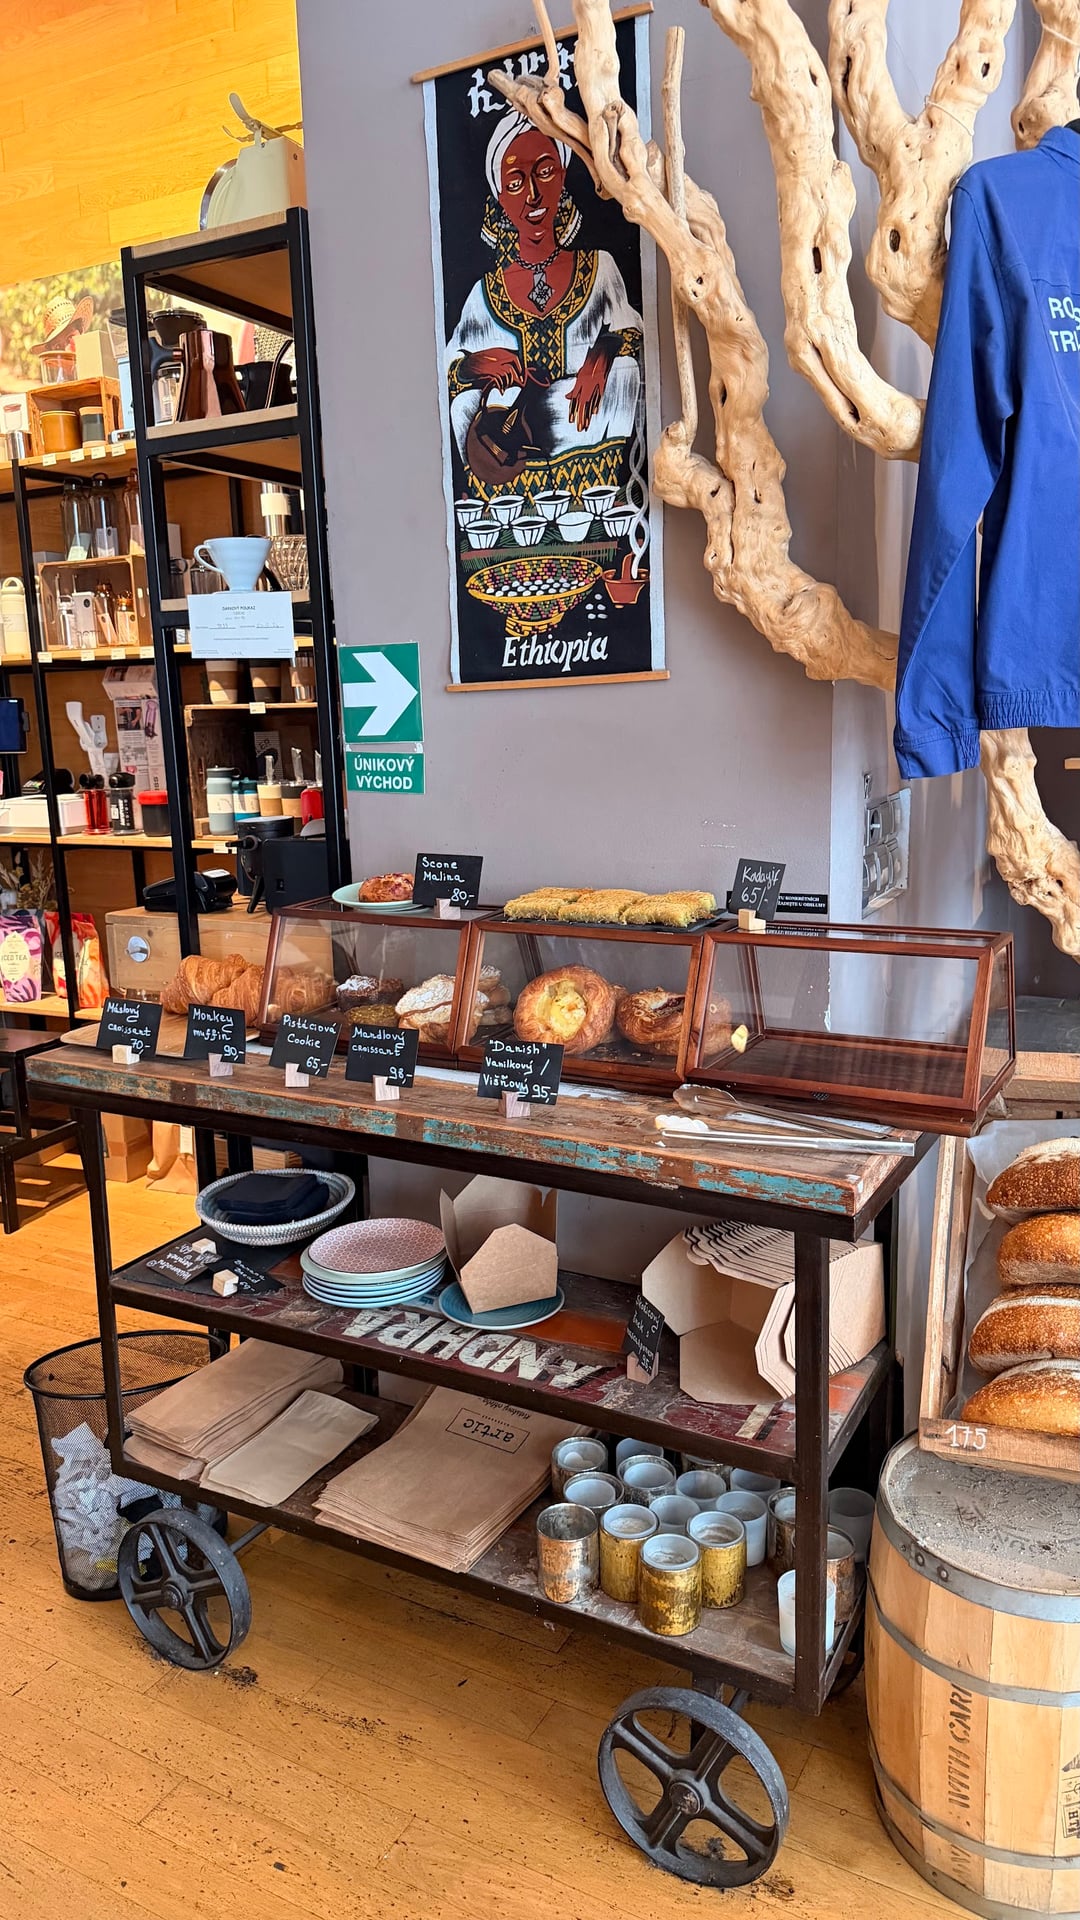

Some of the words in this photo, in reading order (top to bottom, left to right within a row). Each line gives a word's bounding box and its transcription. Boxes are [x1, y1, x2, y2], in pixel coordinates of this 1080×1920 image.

[502, 631, 608, 672] Ethiopia
[354, 754, 415, 772] ÚNIKOVÝ
[356, 772, 413, 790] VÝCHOD
[422, 856, 458, 869] Scone
[423, 871, 465, 883] Malina
[742, 866, 781, 890] Kadayif
[451, 887, 475, 906] 80,-
[106, 1001, 140, 1023] Máslový
[193, 1008, 234, 1034] Monkey
[193, 1028, 231, 1041] muffin
[282, 1014, 337, 1034] Pistáciová
[287, 1034, 321, 1048] Cookie
[352, 1027, 405, 1049] Mandlový
[485, 1056, 534, 1075] Vanilkový
[482, 1073, 530, 1097] Višňový
[463, 1418, 515, 1443] artic
[945, 1424, 988, 1450] 175
[948, 1745, 971, 1809] WITH
